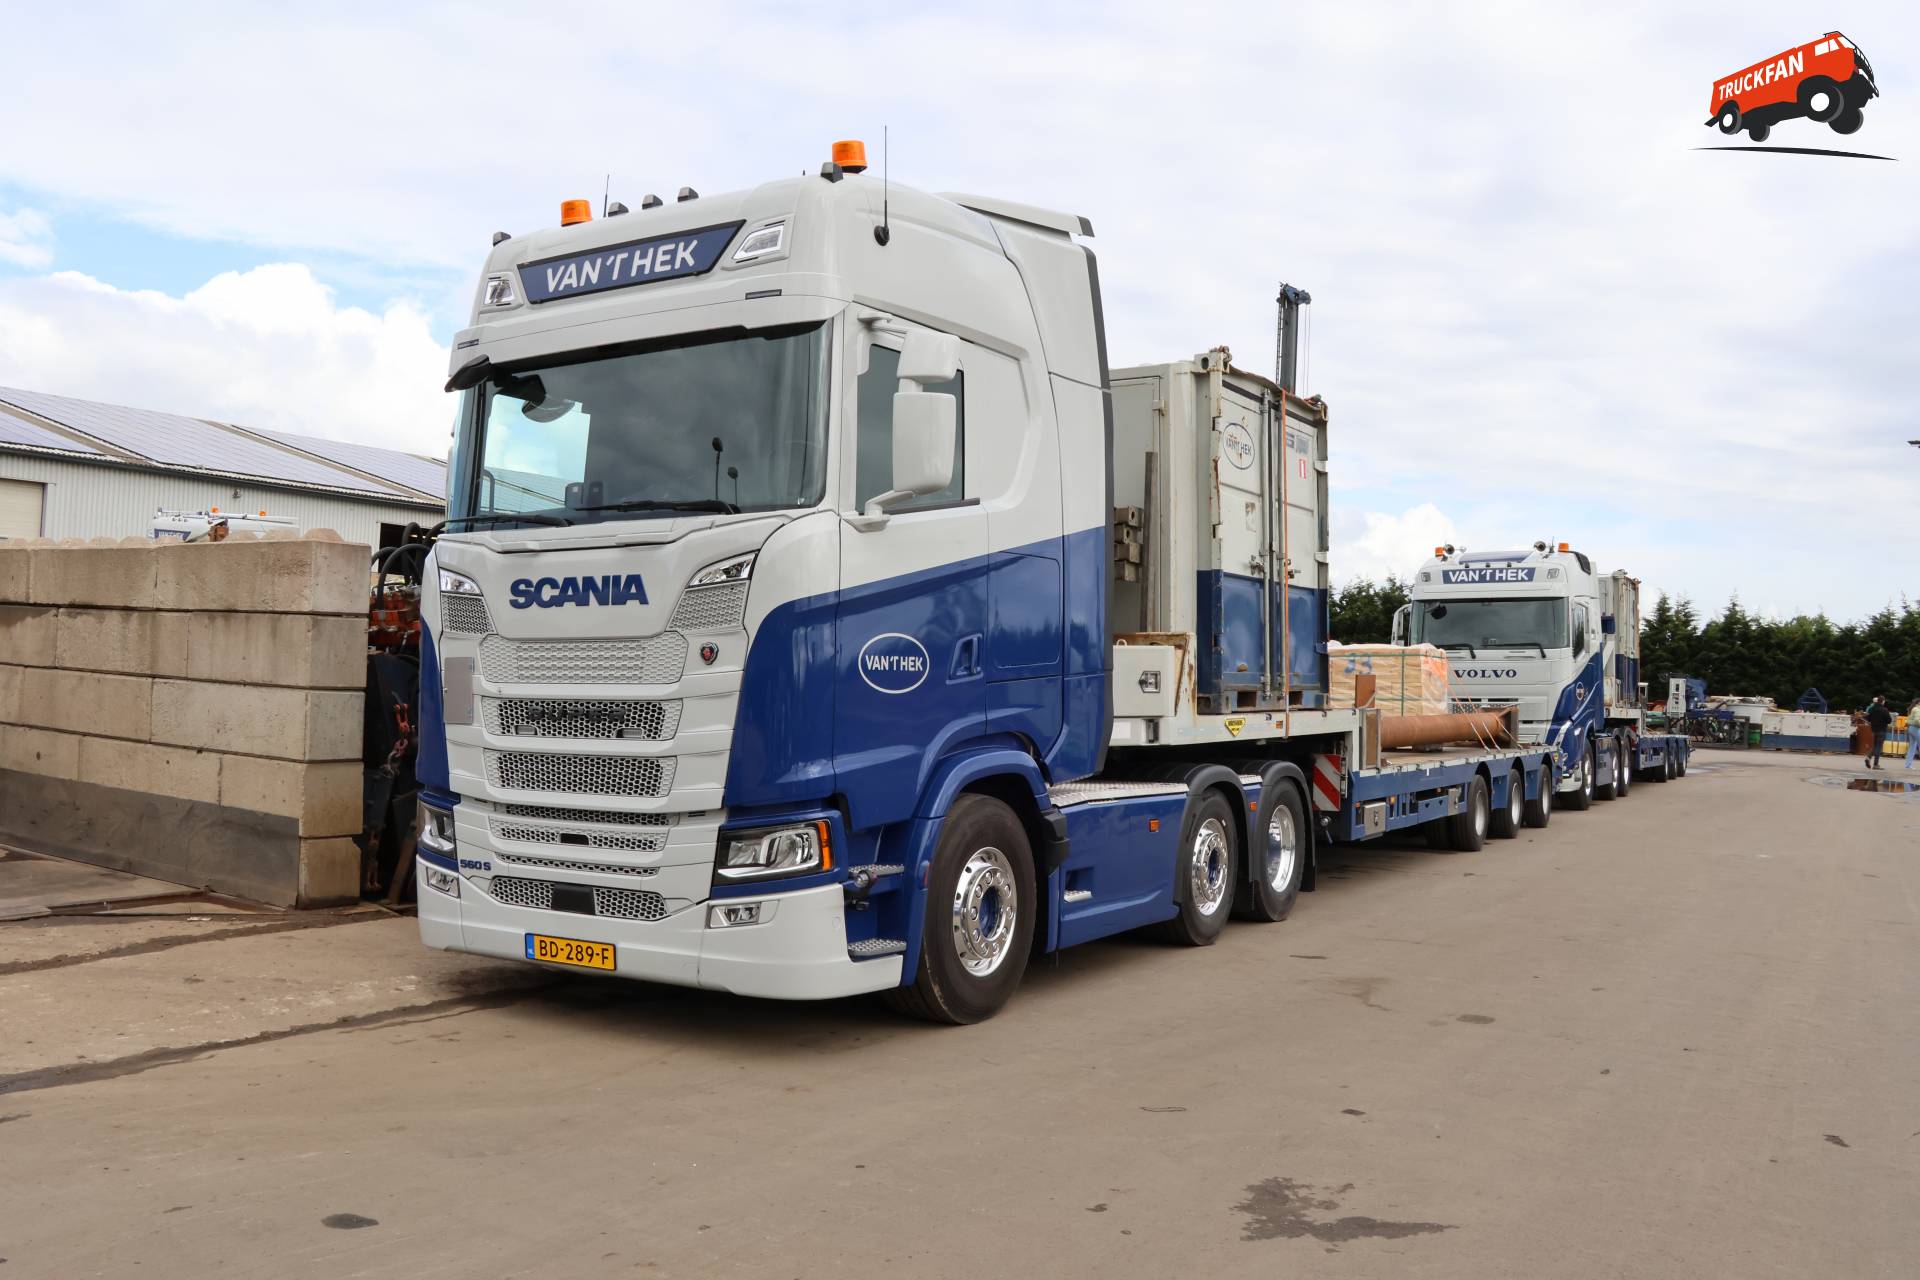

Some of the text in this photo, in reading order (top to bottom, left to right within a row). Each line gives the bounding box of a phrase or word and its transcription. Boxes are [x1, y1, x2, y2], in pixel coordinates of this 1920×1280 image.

[630, 239, 698, 277] HEK
[1495, 569, 1529, 581] HEK
[509, 574, 649, 609] SCANIA
[900, 656, 923, 671] HEK
[1454, 669, 1517, 678] VOLVO
[460, 859, 492, 871] 560 S
[539, 939, 609, 965] BD-289-F
